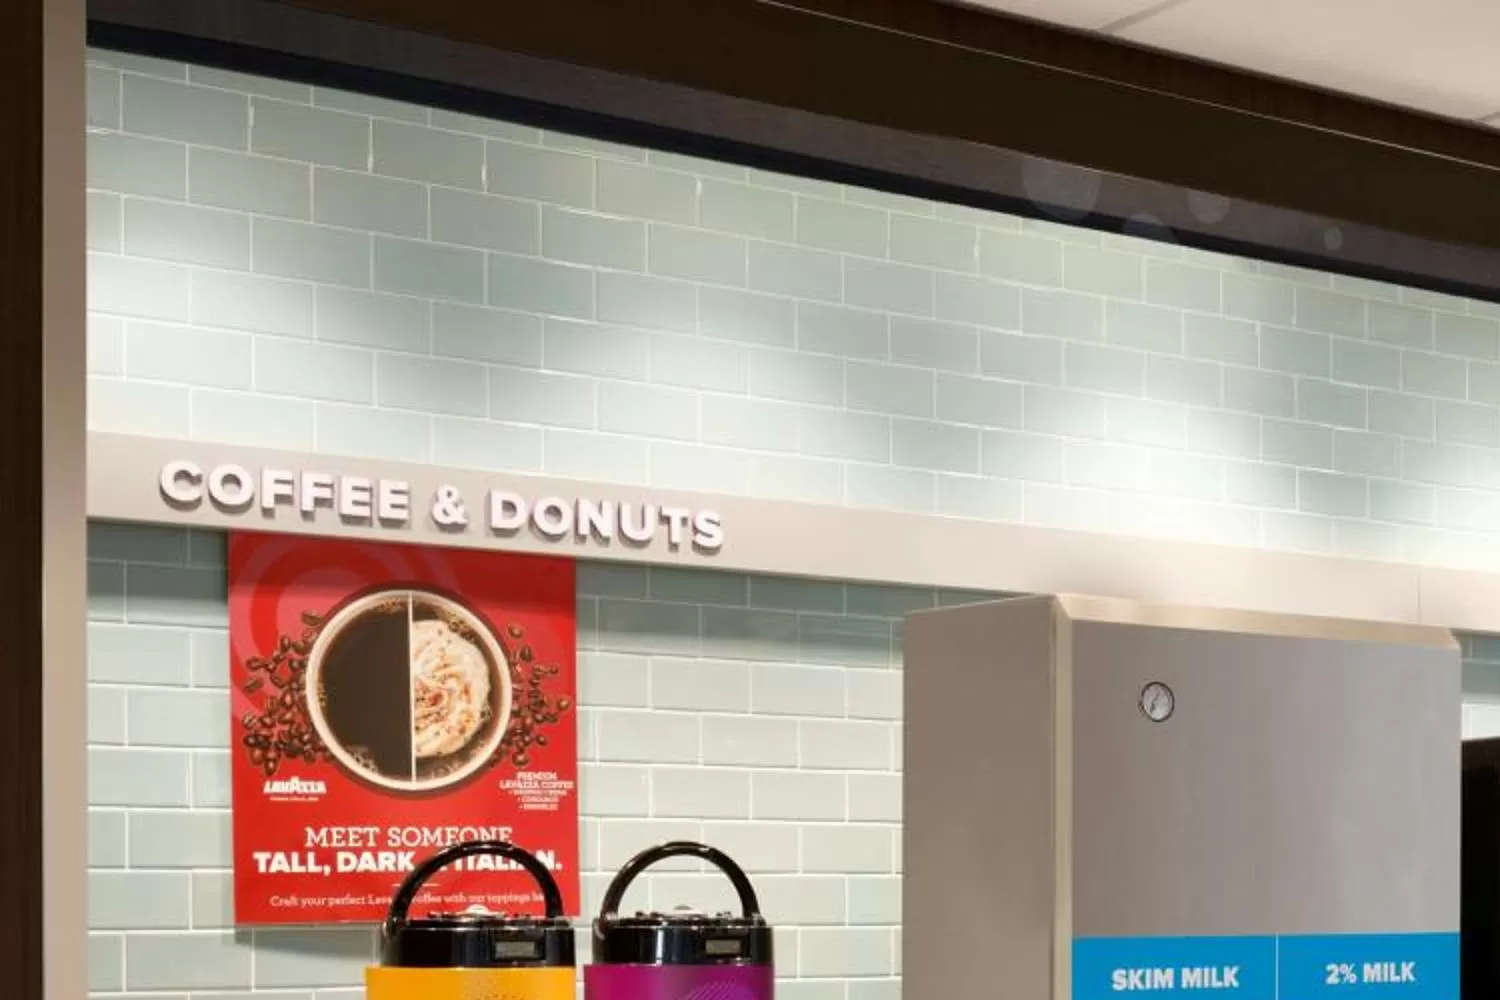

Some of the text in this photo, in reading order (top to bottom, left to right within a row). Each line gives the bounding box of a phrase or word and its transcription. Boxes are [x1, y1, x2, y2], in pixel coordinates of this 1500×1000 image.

[160, 459, 724, 550] COFFEE & DONUTS
[304, 826, 513, 847] MEET SOMEONE
[253, 851, 331, 876] TALL,
[336, 851, 416, 873] DARK
[269, 893, 299, 907] Craft
[302, 896, 326, 908] your
[328, 893, 366, 908] perfect
[1111, 966, 1240, 991] SKIM MILK
[1325, 961, 1416, 985] 2% MILK
